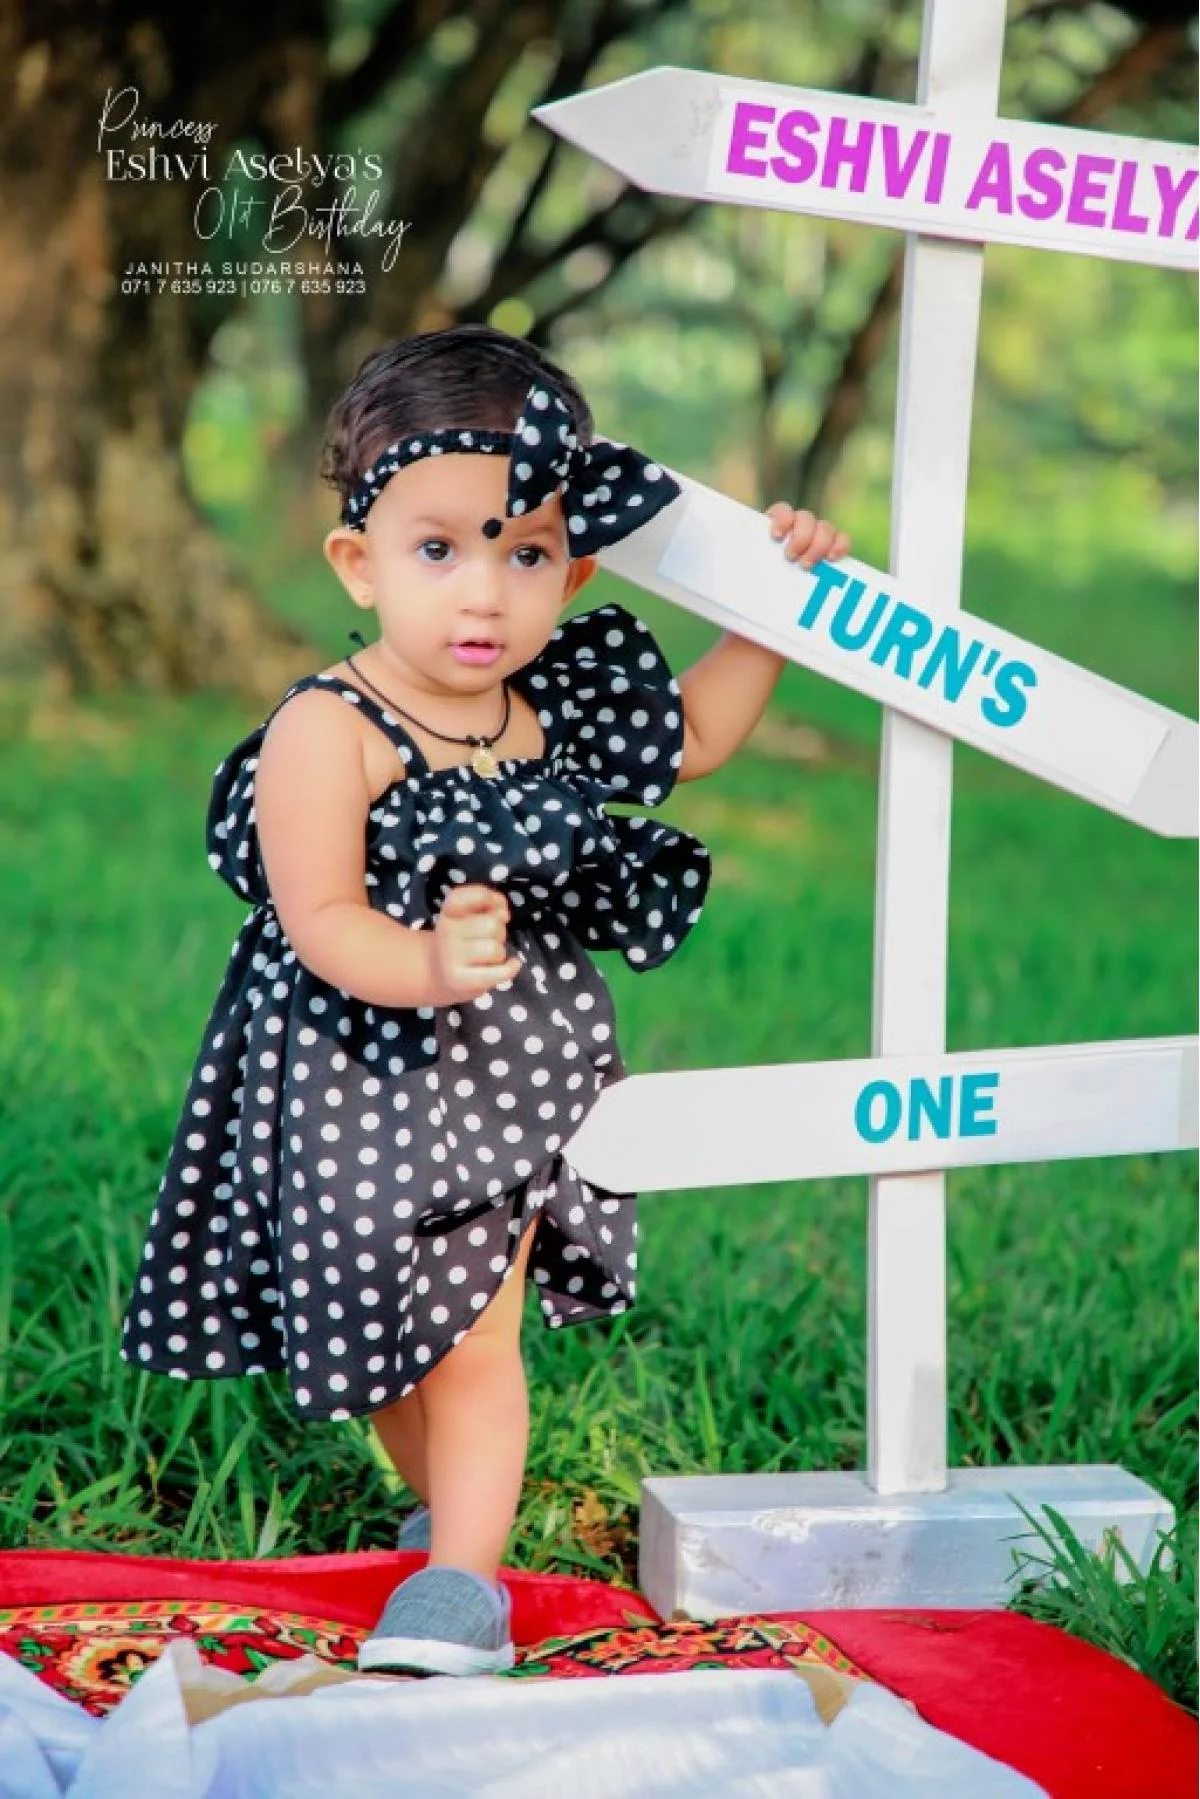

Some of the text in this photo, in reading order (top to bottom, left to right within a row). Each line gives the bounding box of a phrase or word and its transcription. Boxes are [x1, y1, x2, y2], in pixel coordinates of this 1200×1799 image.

[726, 103, 1199, 241] ESHVI ASELY
[798, 561, 1038, 728] TURN'S
[854, 1072, 1000, 1144] ONE
